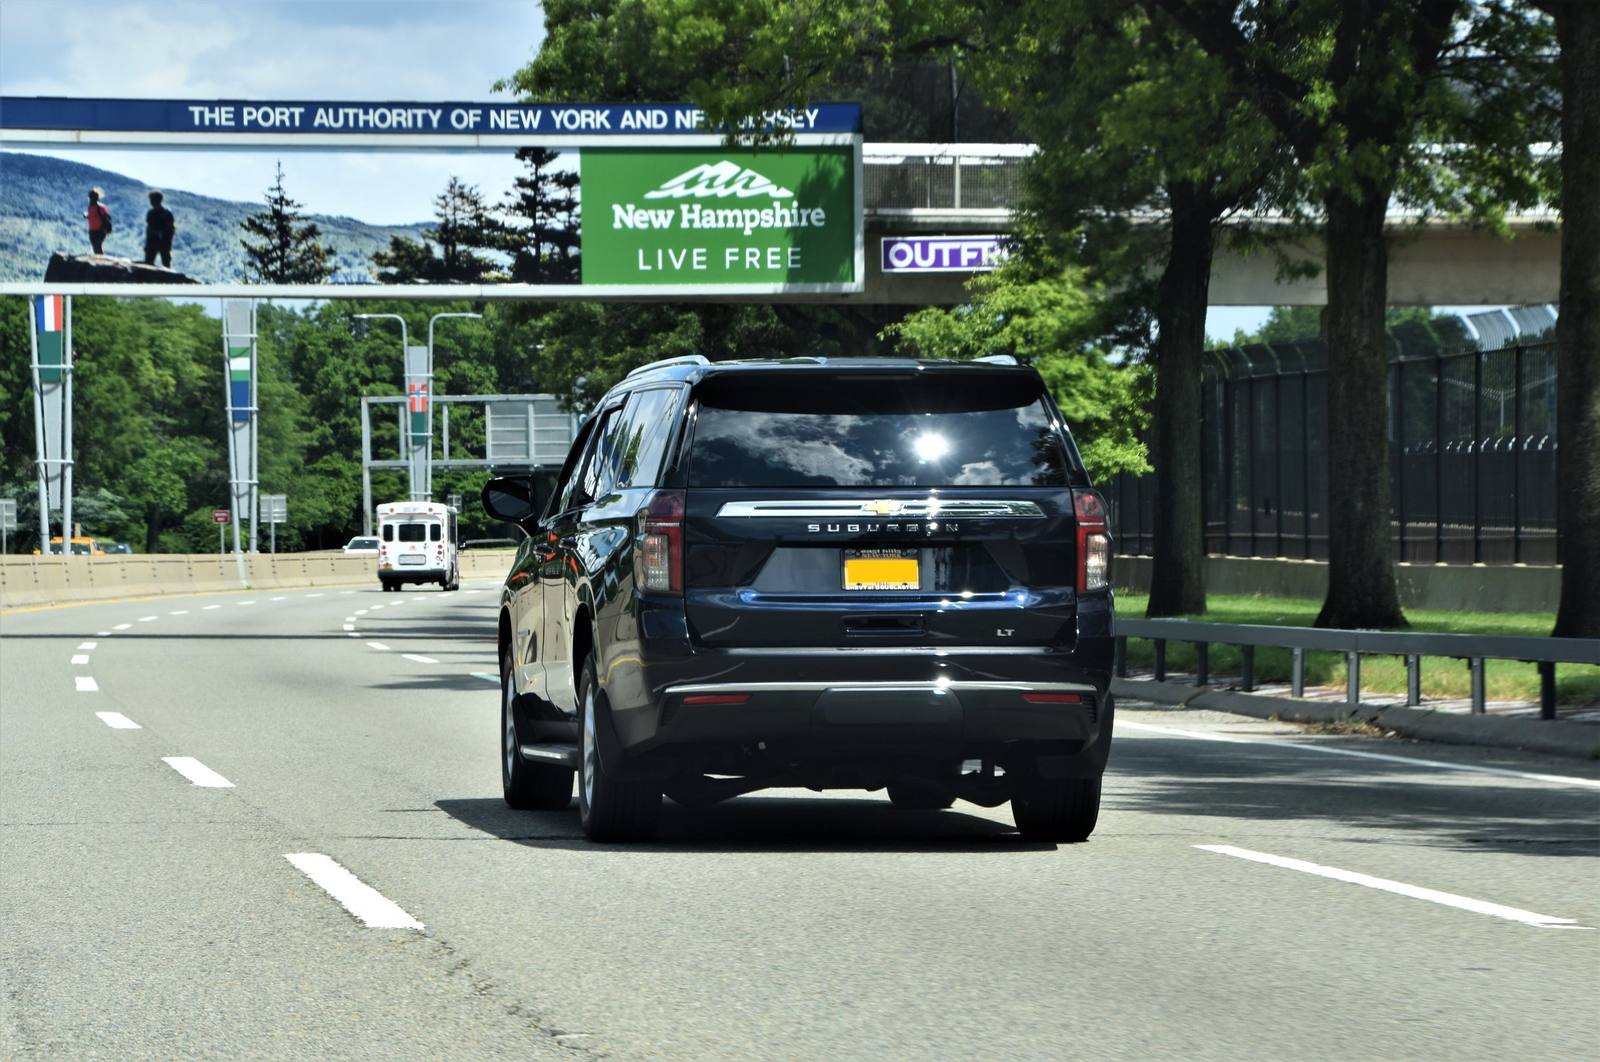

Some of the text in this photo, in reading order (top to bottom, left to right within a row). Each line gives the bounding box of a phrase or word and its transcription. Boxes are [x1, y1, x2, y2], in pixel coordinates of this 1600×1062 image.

[188, 105, 235, 126] THE
[243, 106, 305, 127] PORT
[313, 107, 442, 129] AUTHORITY
[450, 108, 482, 129] OF
[489, 109, 542, 129] NEW
[550, 108, 611, 129] YORK
[620, 109, 668, 129] AND
[675, 109, 721, 129] NE
[611, 201, 826, 235] New Hampshire
[638, 247, 801, 270] LIVE FREE
[996, 628, 1016, 637] LT
